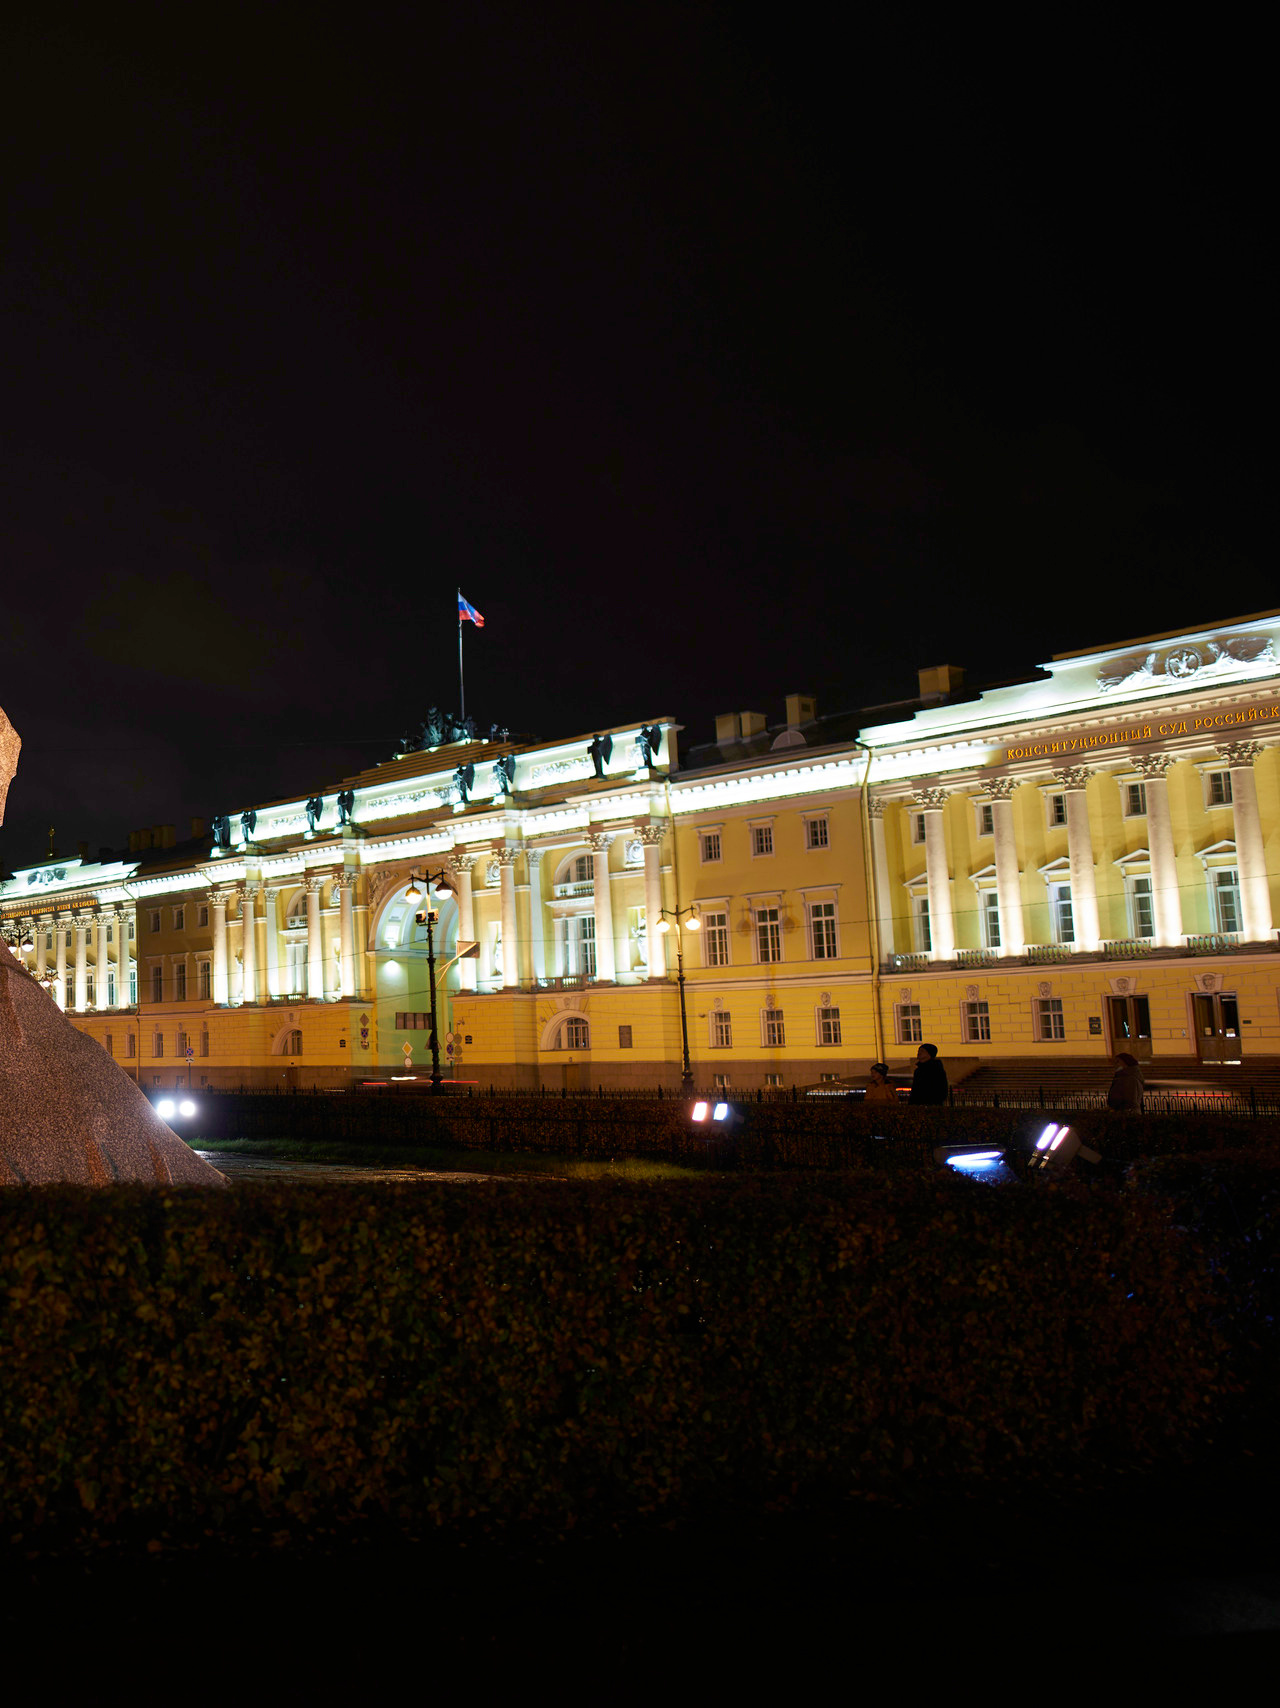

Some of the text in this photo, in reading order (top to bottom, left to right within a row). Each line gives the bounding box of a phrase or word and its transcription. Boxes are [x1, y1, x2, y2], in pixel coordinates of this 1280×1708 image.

[1007, 706, 1280, 760] КОНСТИТУЦИОННЫЙ СУД РОССИЙСК
